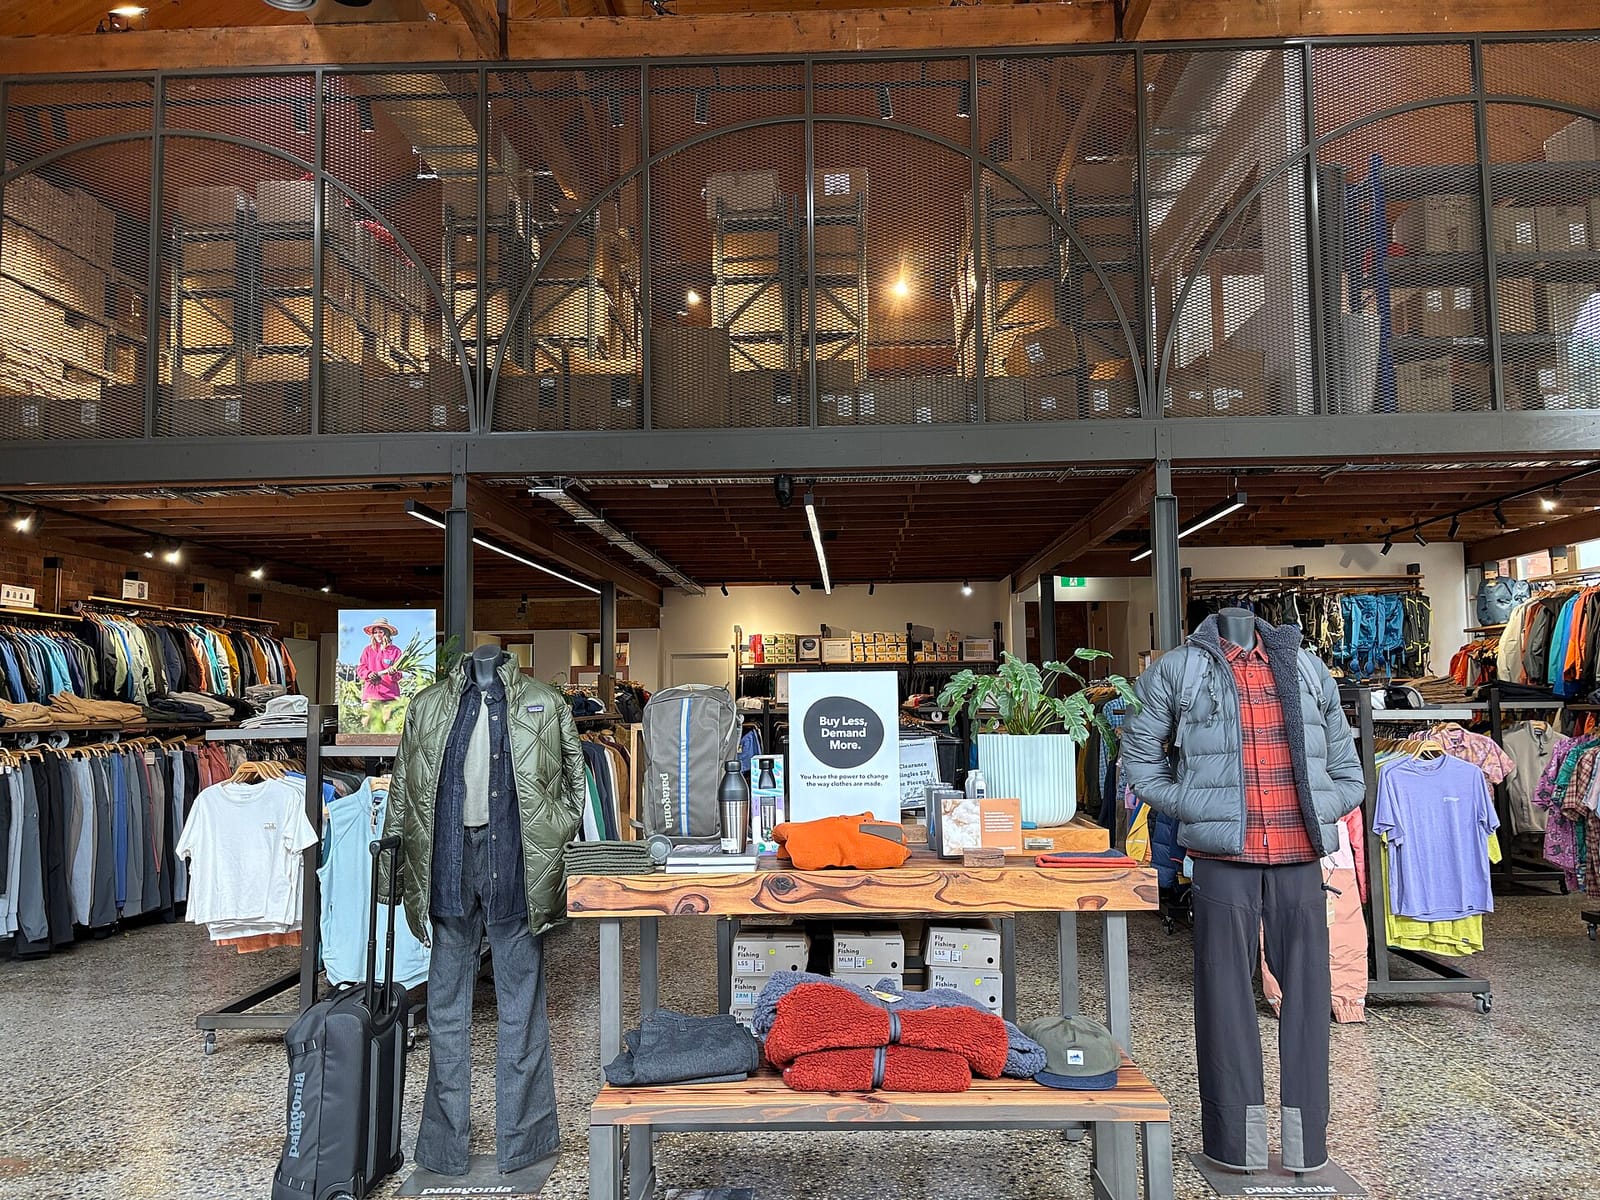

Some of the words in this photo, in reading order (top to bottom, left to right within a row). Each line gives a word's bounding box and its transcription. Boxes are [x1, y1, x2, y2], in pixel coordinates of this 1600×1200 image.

[819, 716, 840, 729] Buy
[842, 716, 868, 728] Less,
[821, 728, 867, 738] Demand
[829, 740, 862, 750] More.
[660, 773, 674, 828] patagonia
[934, 934, 944, 942] Fly
[934, 941, 957, 949] Fishing
[935, 981, 958, 989] Fishing
[288, 1072, 306, 1158] patagonia
[421, 1186, 514, 1195] patagonia
[1243, 1185, 1338, 1195] patagonia
